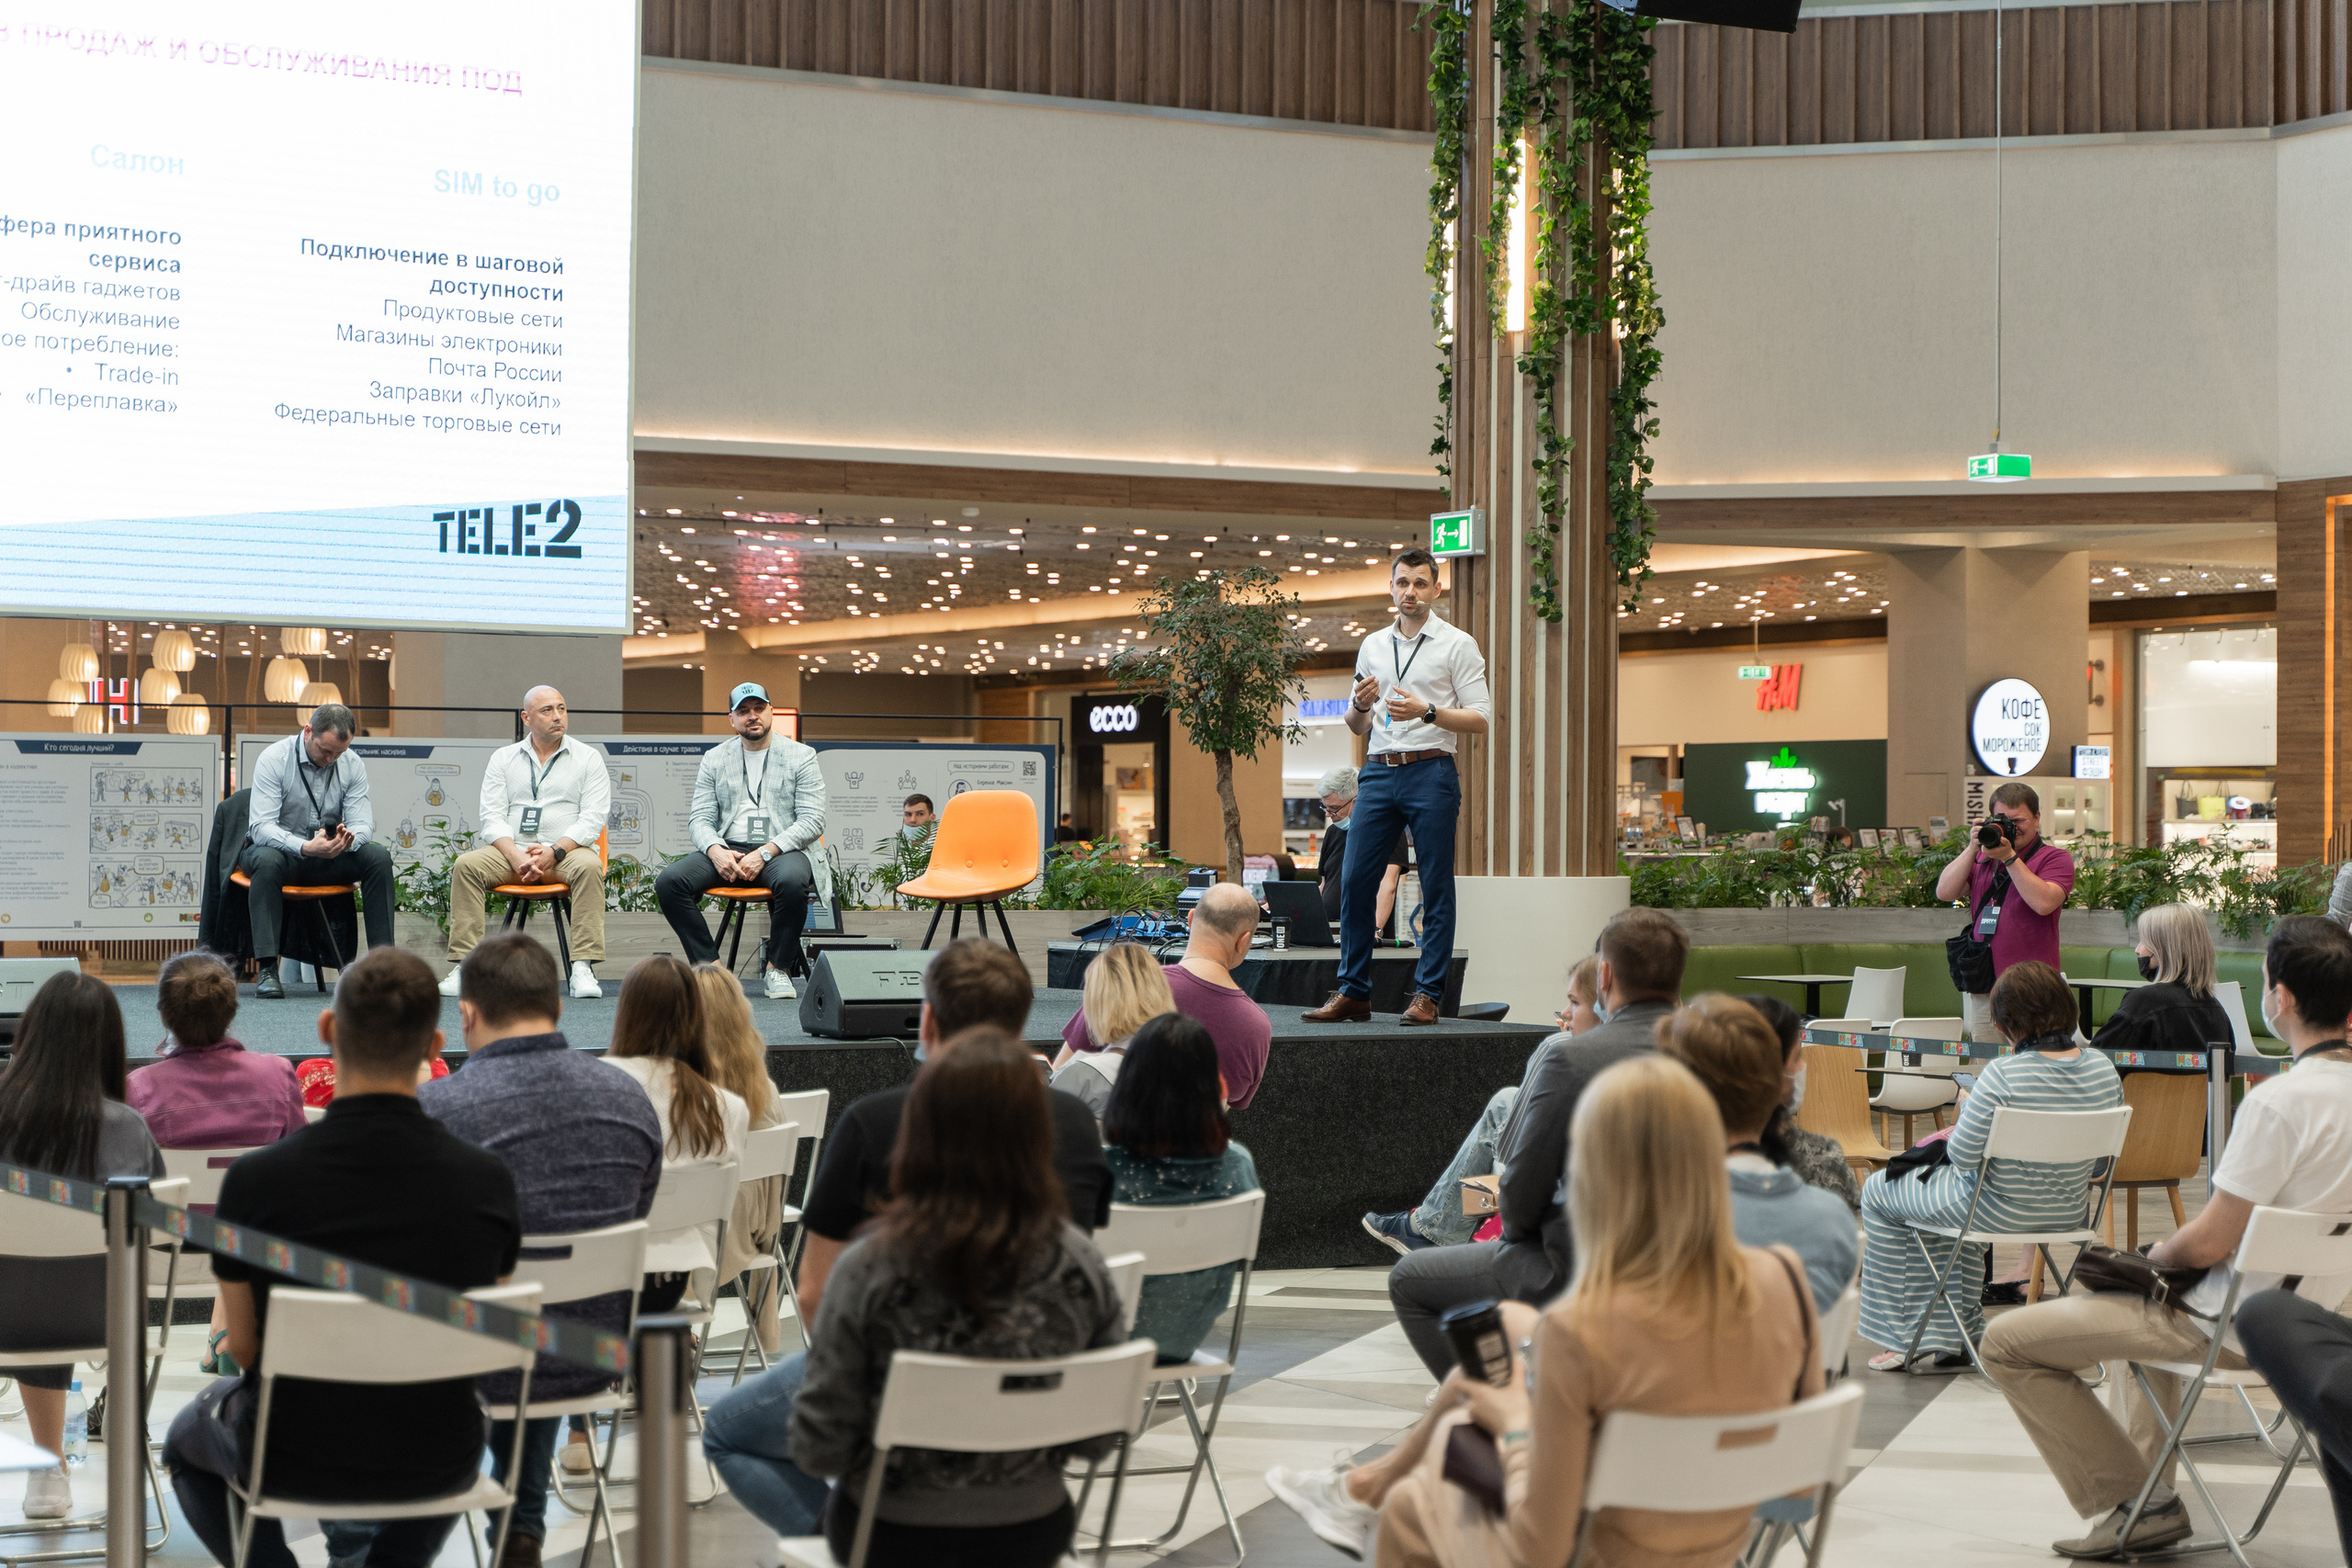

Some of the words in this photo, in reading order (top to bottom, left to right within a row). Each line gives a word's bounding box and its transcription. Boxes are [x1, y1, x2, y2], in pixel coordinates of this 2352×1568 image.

[22, 21, 158, 58] ПРОДАЖ
[170, 36, 187, 61] И
[198, 39, 452, 86] ОБСЛУЖИВАНИЯ
[462, 65, 523, 97] ПОД
[90, 143, 185, 175] Салон
[434, 168, 483, 196] SIM
[492, 175, 518, 198] to
[526, 181, 560, 208] go
[64, 223, 182, 244] приятного
[88, 254, 181, 274] сервиса
[300, 238, 449, 265] Подключение
[457, 254, 468, 267] в
[476, 257, 563, 275] шаговой
[0, 275, 75, 294] -драйв
[84, 281, 181, 301] гаджетов
[429, 279, 563, 301] доступности
[21, 301, 180, 330] Обслуживание
[384, 299, 514, 324] Продуктовые
[521, 311, 563, 328] сети
[1, 333, 27, 347] ое
[35, 334, 179, 357] потребление:
[336, 323, 435, 347] Магазины
[441, 333, 562, 356] электроники
[95, 363, 179, 385] Trade-in
[428, 357, 487, 378] Почта
[494, 361, 562, 382] России
[26, 388, 178, 412] «Переплавка»
[369, 380, 462, 403] Заправки
[469, 388, 560, 410] «Лукойл»
[275, 401, 415, 427] Федеральные
[423, 414, 513, 434] торговые
[519, 421, 561, 435] сети
[433, 499, 582, 558] TELE2
[1090, 705, 1139, 733] ecco
[2001, 698, 2042, 720] КОФЕ
[2024, 723, 2042, 737] СОК
[44, 742, 58, 751] Кто
[622, 745, 653, 753] Действия
[659, 746, 679, 754] случае
[1983, 738, 2042, 752] МОРОЖЕНОЕ
[1276, 933, 1285, 948] ONE
